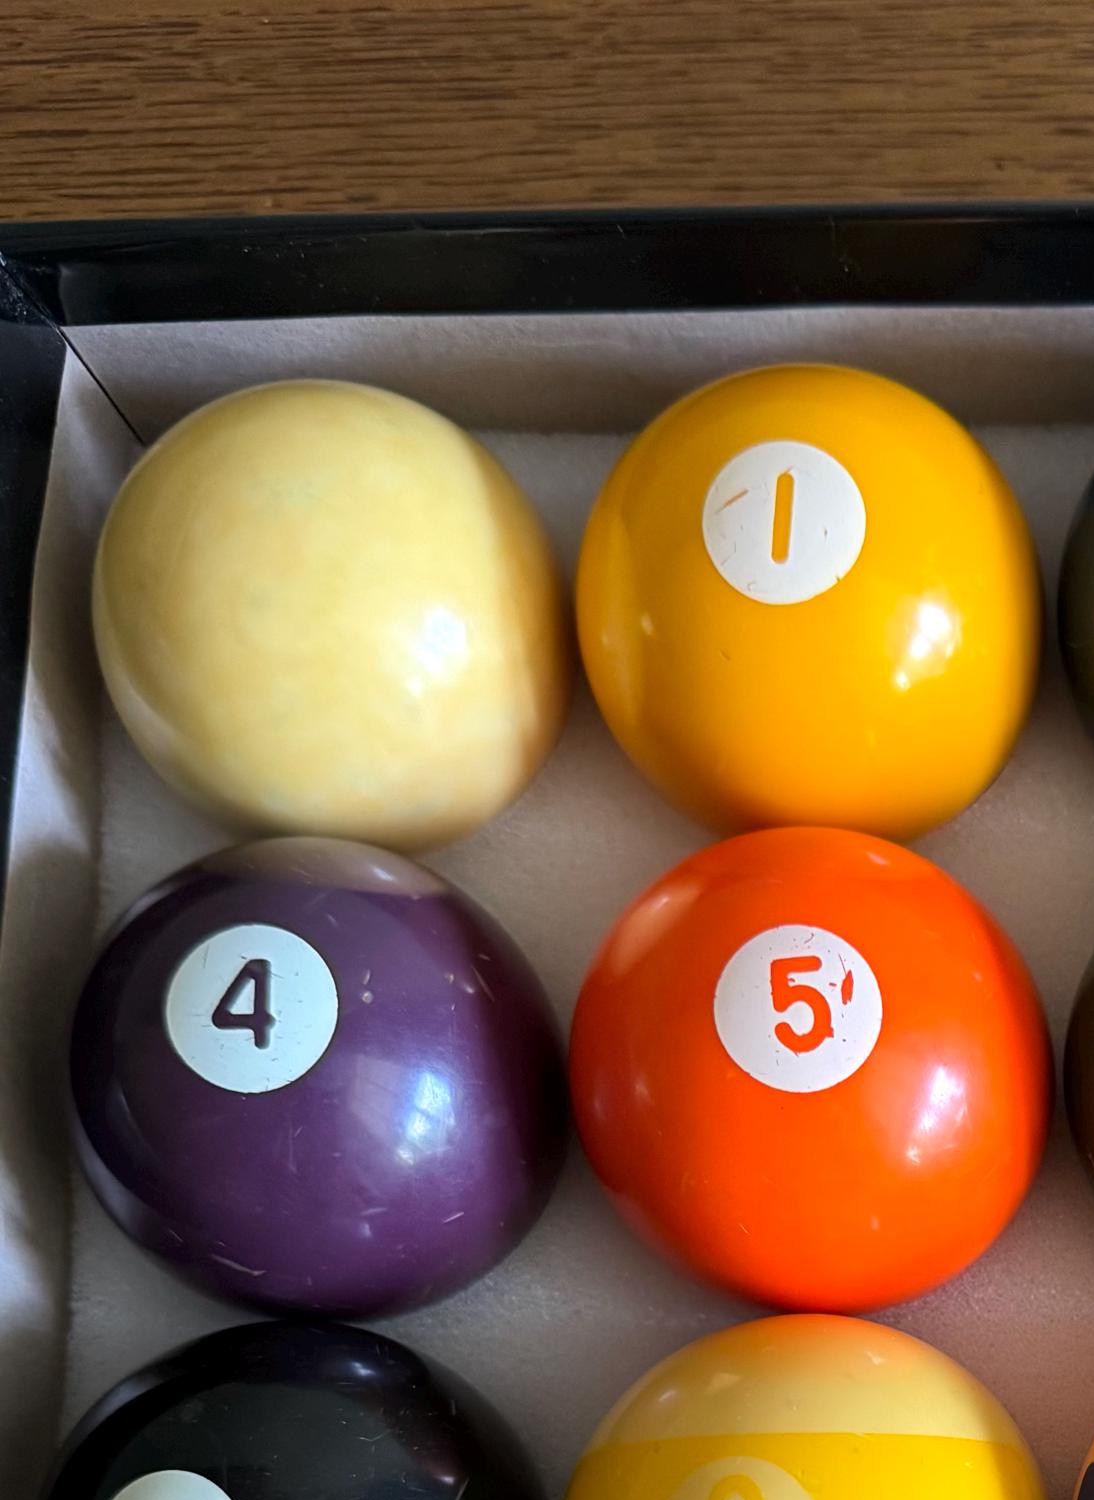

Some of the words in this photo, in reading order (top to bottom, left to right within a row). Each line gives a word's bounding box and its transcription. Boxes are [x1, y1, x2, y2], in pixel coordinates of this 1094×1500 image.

[771, 472, 795, 564] 1
[212, 959, 276, 1049] 4
[770, 955, 834, 1055] 5
